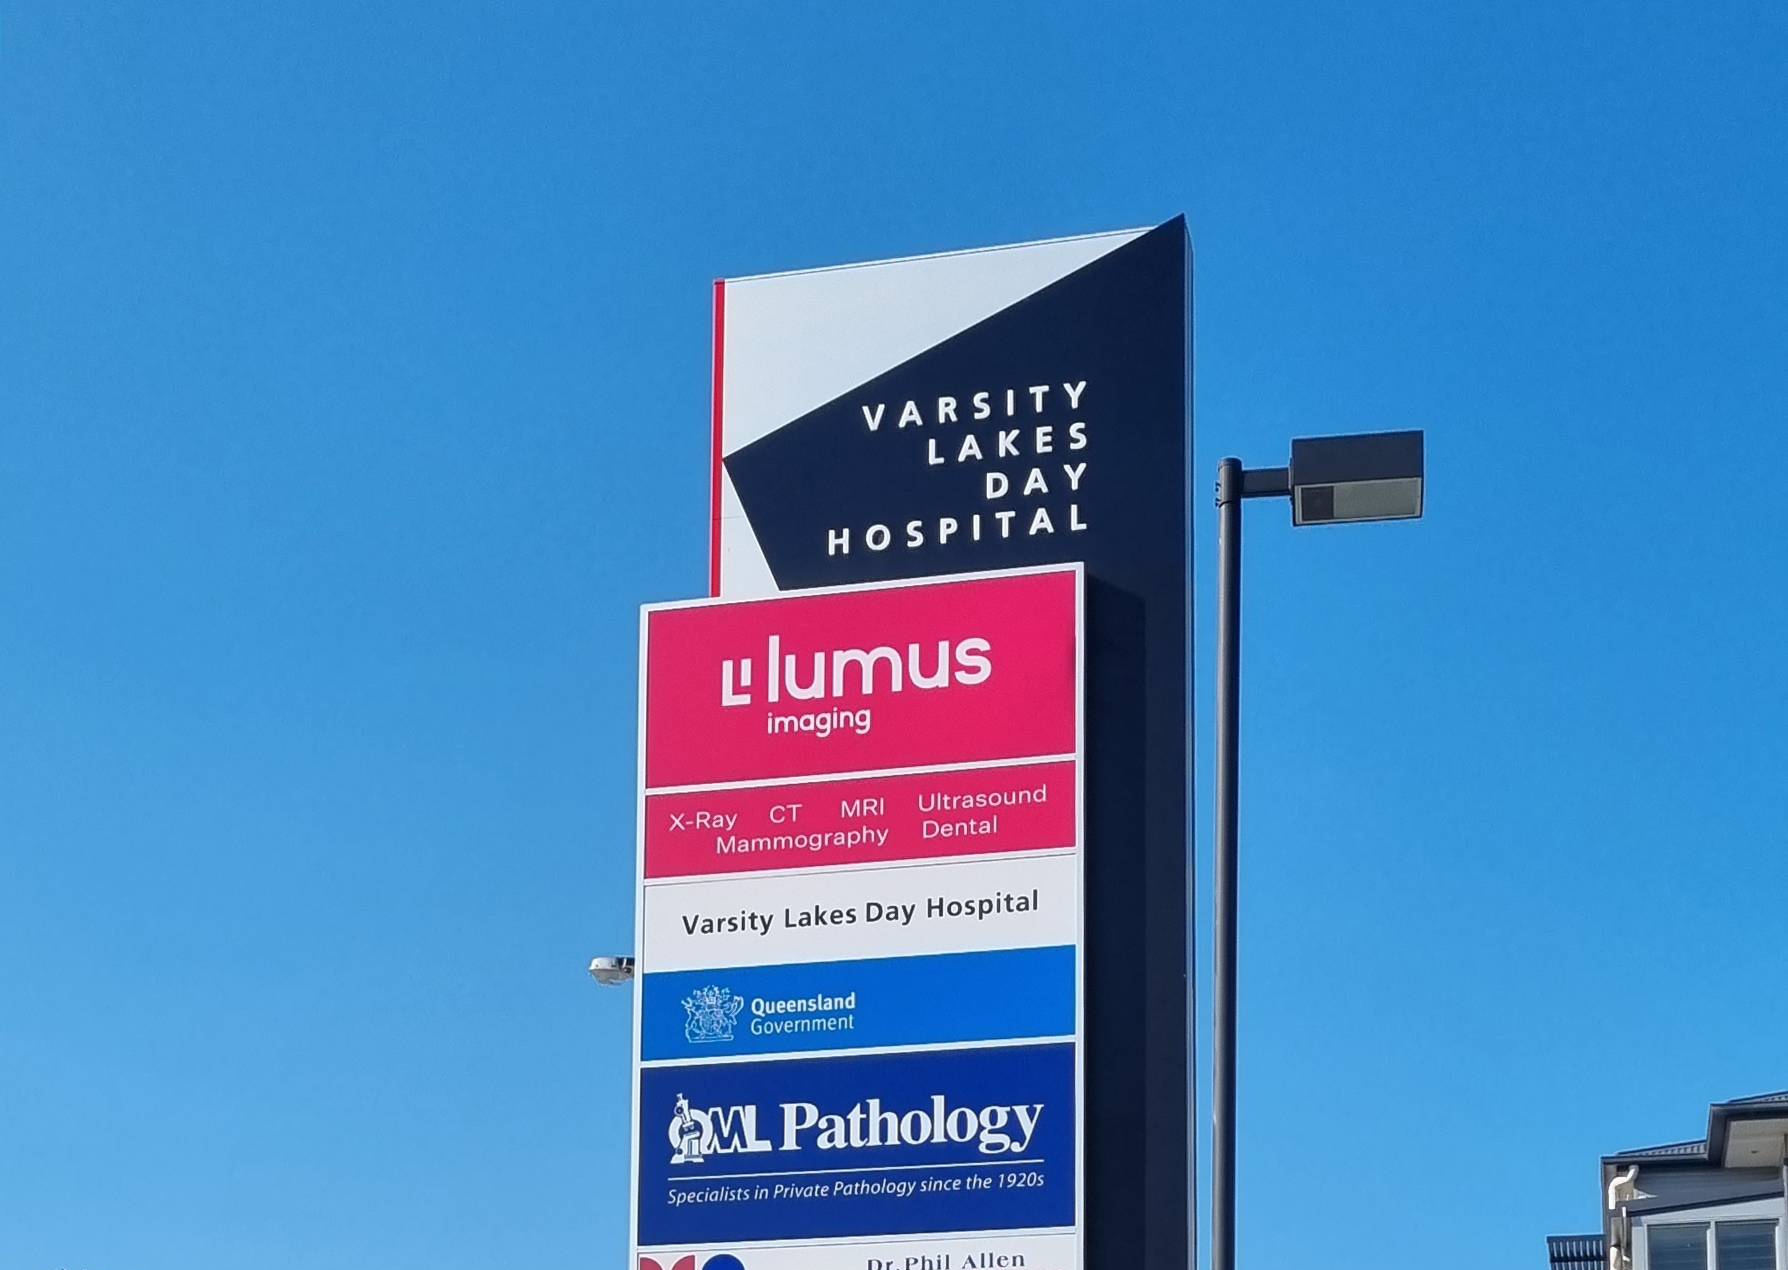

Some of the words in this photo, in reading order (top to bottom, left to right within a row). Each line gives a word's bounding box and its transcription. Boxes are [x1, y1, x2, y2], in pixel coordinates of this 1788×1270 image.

[862, 381, 1087, 431] VARSITY
[928, 422, 1087, 465] LAKES
[986, 463, 1087, 500] DAY
[828, 504, 1087, 555] HOSPITAL
[768, 634, 992, 703] lumus
[767, 707, 871, 738] imaging
[669, 810, 738, 832] X-Ray
[769, 804, 802, 824] CT
[840, 797, 885, 818] MRI
[917, 784, 1047, 812] Ultrasound
[716, 825, 889, 855] Mammography
[922, 816, 998, 839] Dental
[682, 909, 774, 936] Varsity
[785, 904, 857, 929] Lakes
[866, 899, 915, 926] Day
[926, 889, 1039, 919] Hospital
[751, 992, 856, 1016] Queensland
[751, 1013, 855, 1036] Government
[778, 1095, 1044, 1154] Pathology
[667, 1186, 750, 1206] Specialists
[754, 1184, 768, 1200] in
[773, 1183, 830, 1199] Private
[833, 1177, 916, 1197] Pathology
[920, 1176, 963, 1191] since
[966, 1173, 992, 1190] the
[998, 1172, 1044, 1188] 1920s
[962, 1252, 1025, 1270] Allen
